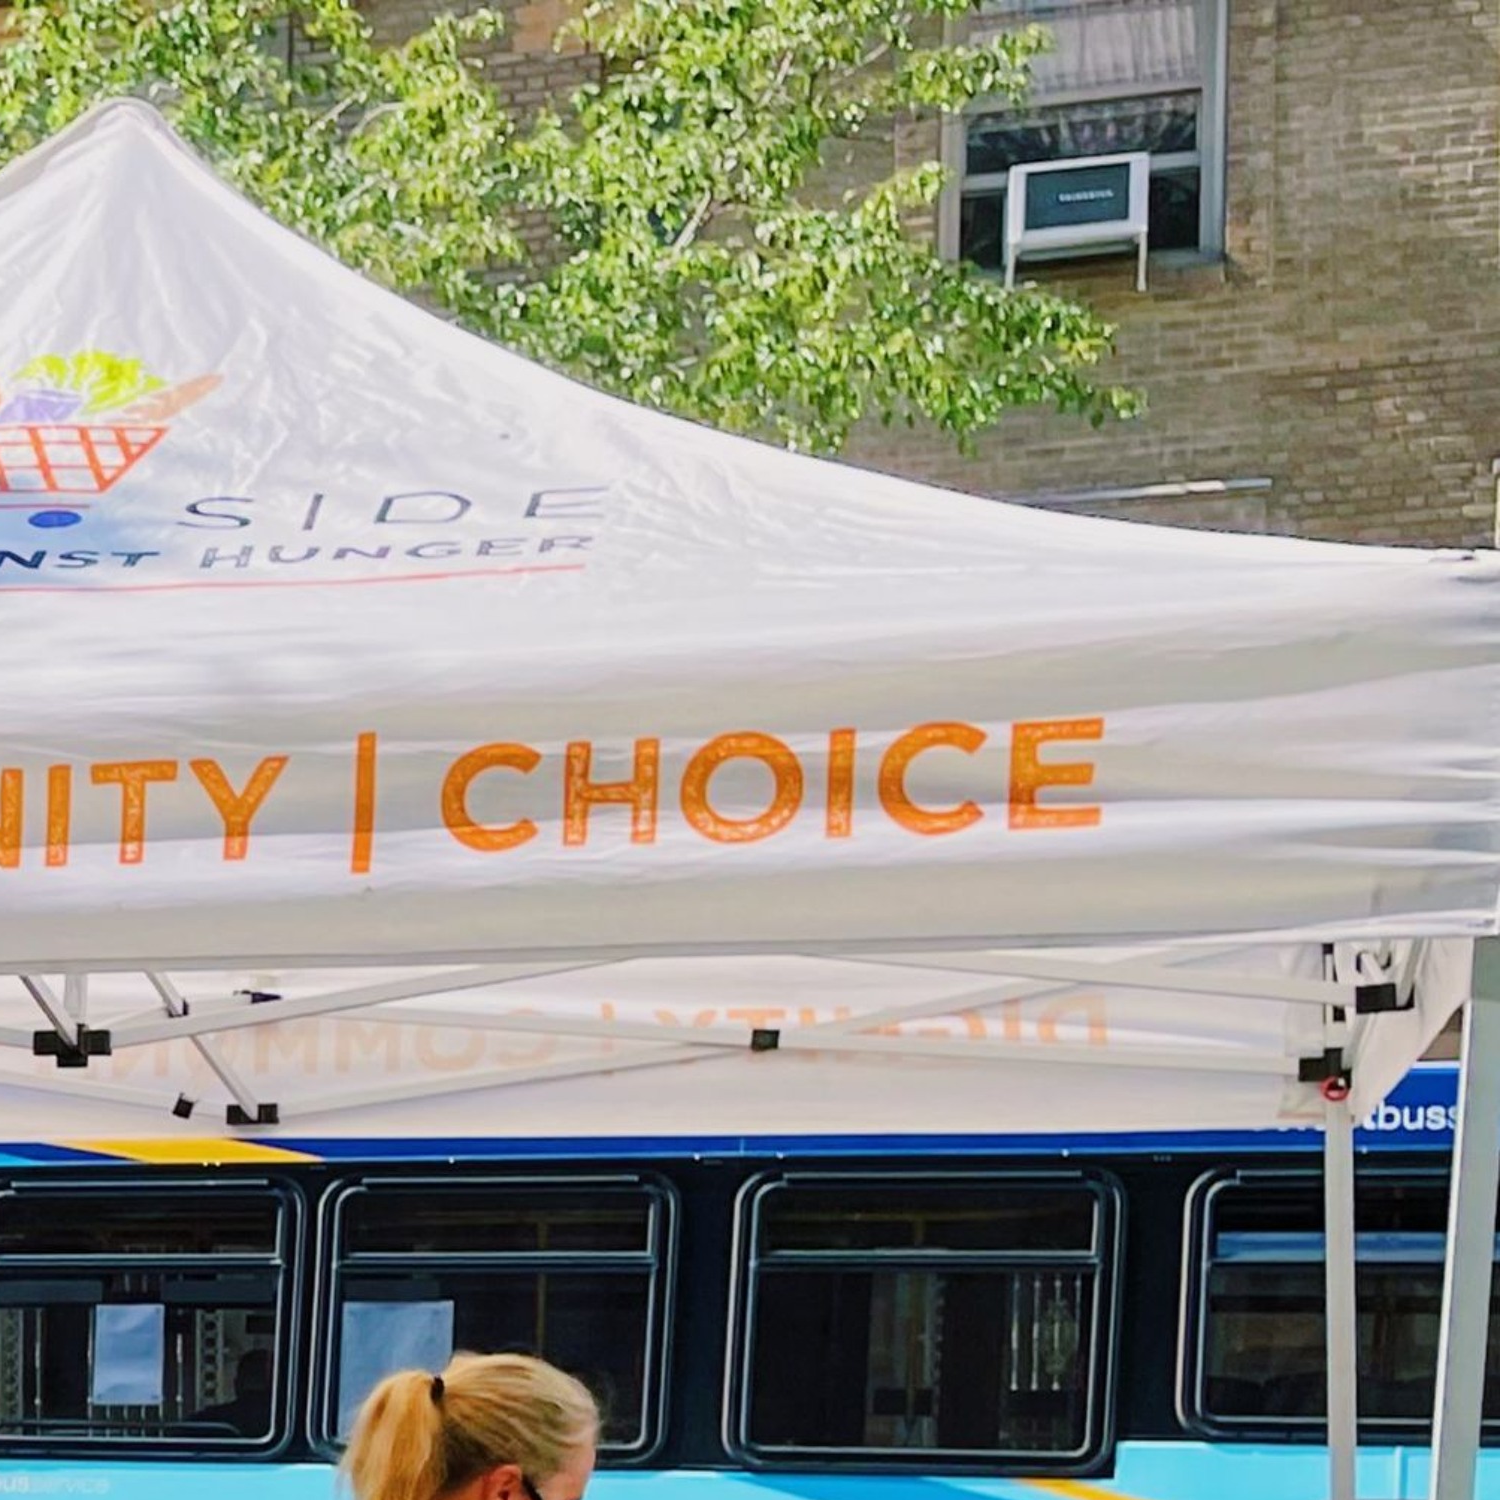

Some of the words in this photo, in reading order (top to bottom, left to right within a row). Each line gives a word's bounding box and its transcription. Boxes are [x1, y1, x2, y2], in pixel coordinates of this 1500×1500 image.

[177, 485, 610, 531] SIDE
[199, 535, 595, 570] HUNGER
[440, 716, 1105, 853] CHOICE
